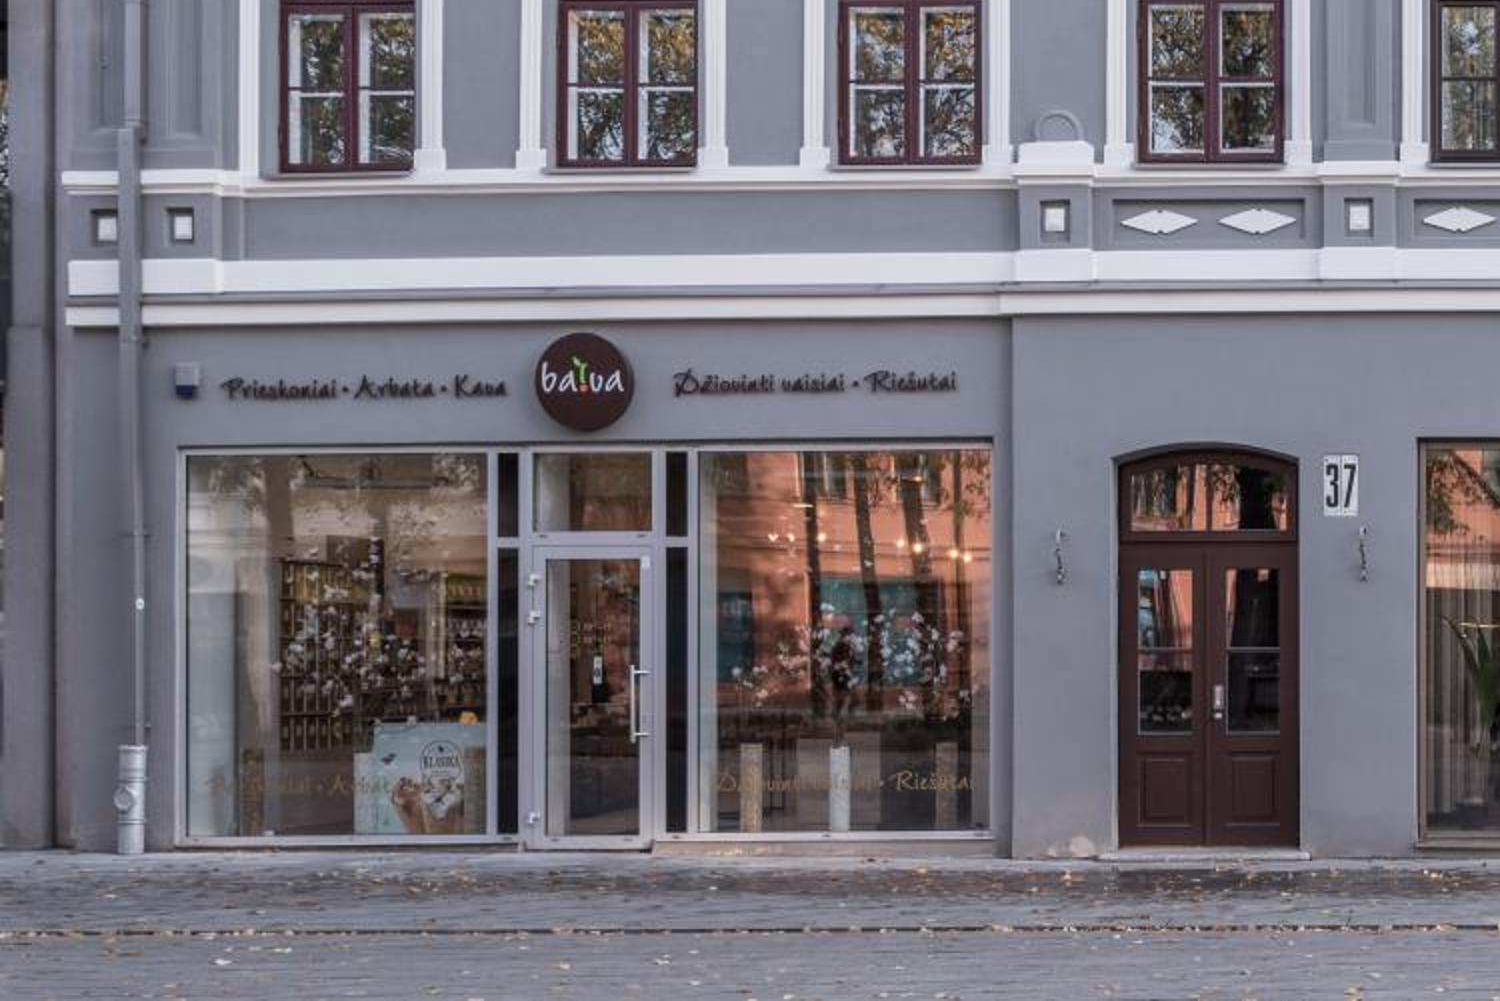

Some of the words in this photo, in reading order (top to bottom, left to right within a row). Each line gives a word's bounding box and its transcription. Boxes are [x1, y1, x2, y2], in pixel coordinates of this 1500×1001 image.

[354, 375, 436, 399] Arbata
[454, 375, 507, 399] Kava
[780, 374, 845, 394] vaisiai
[1326, 463, 1357, 508] 37
